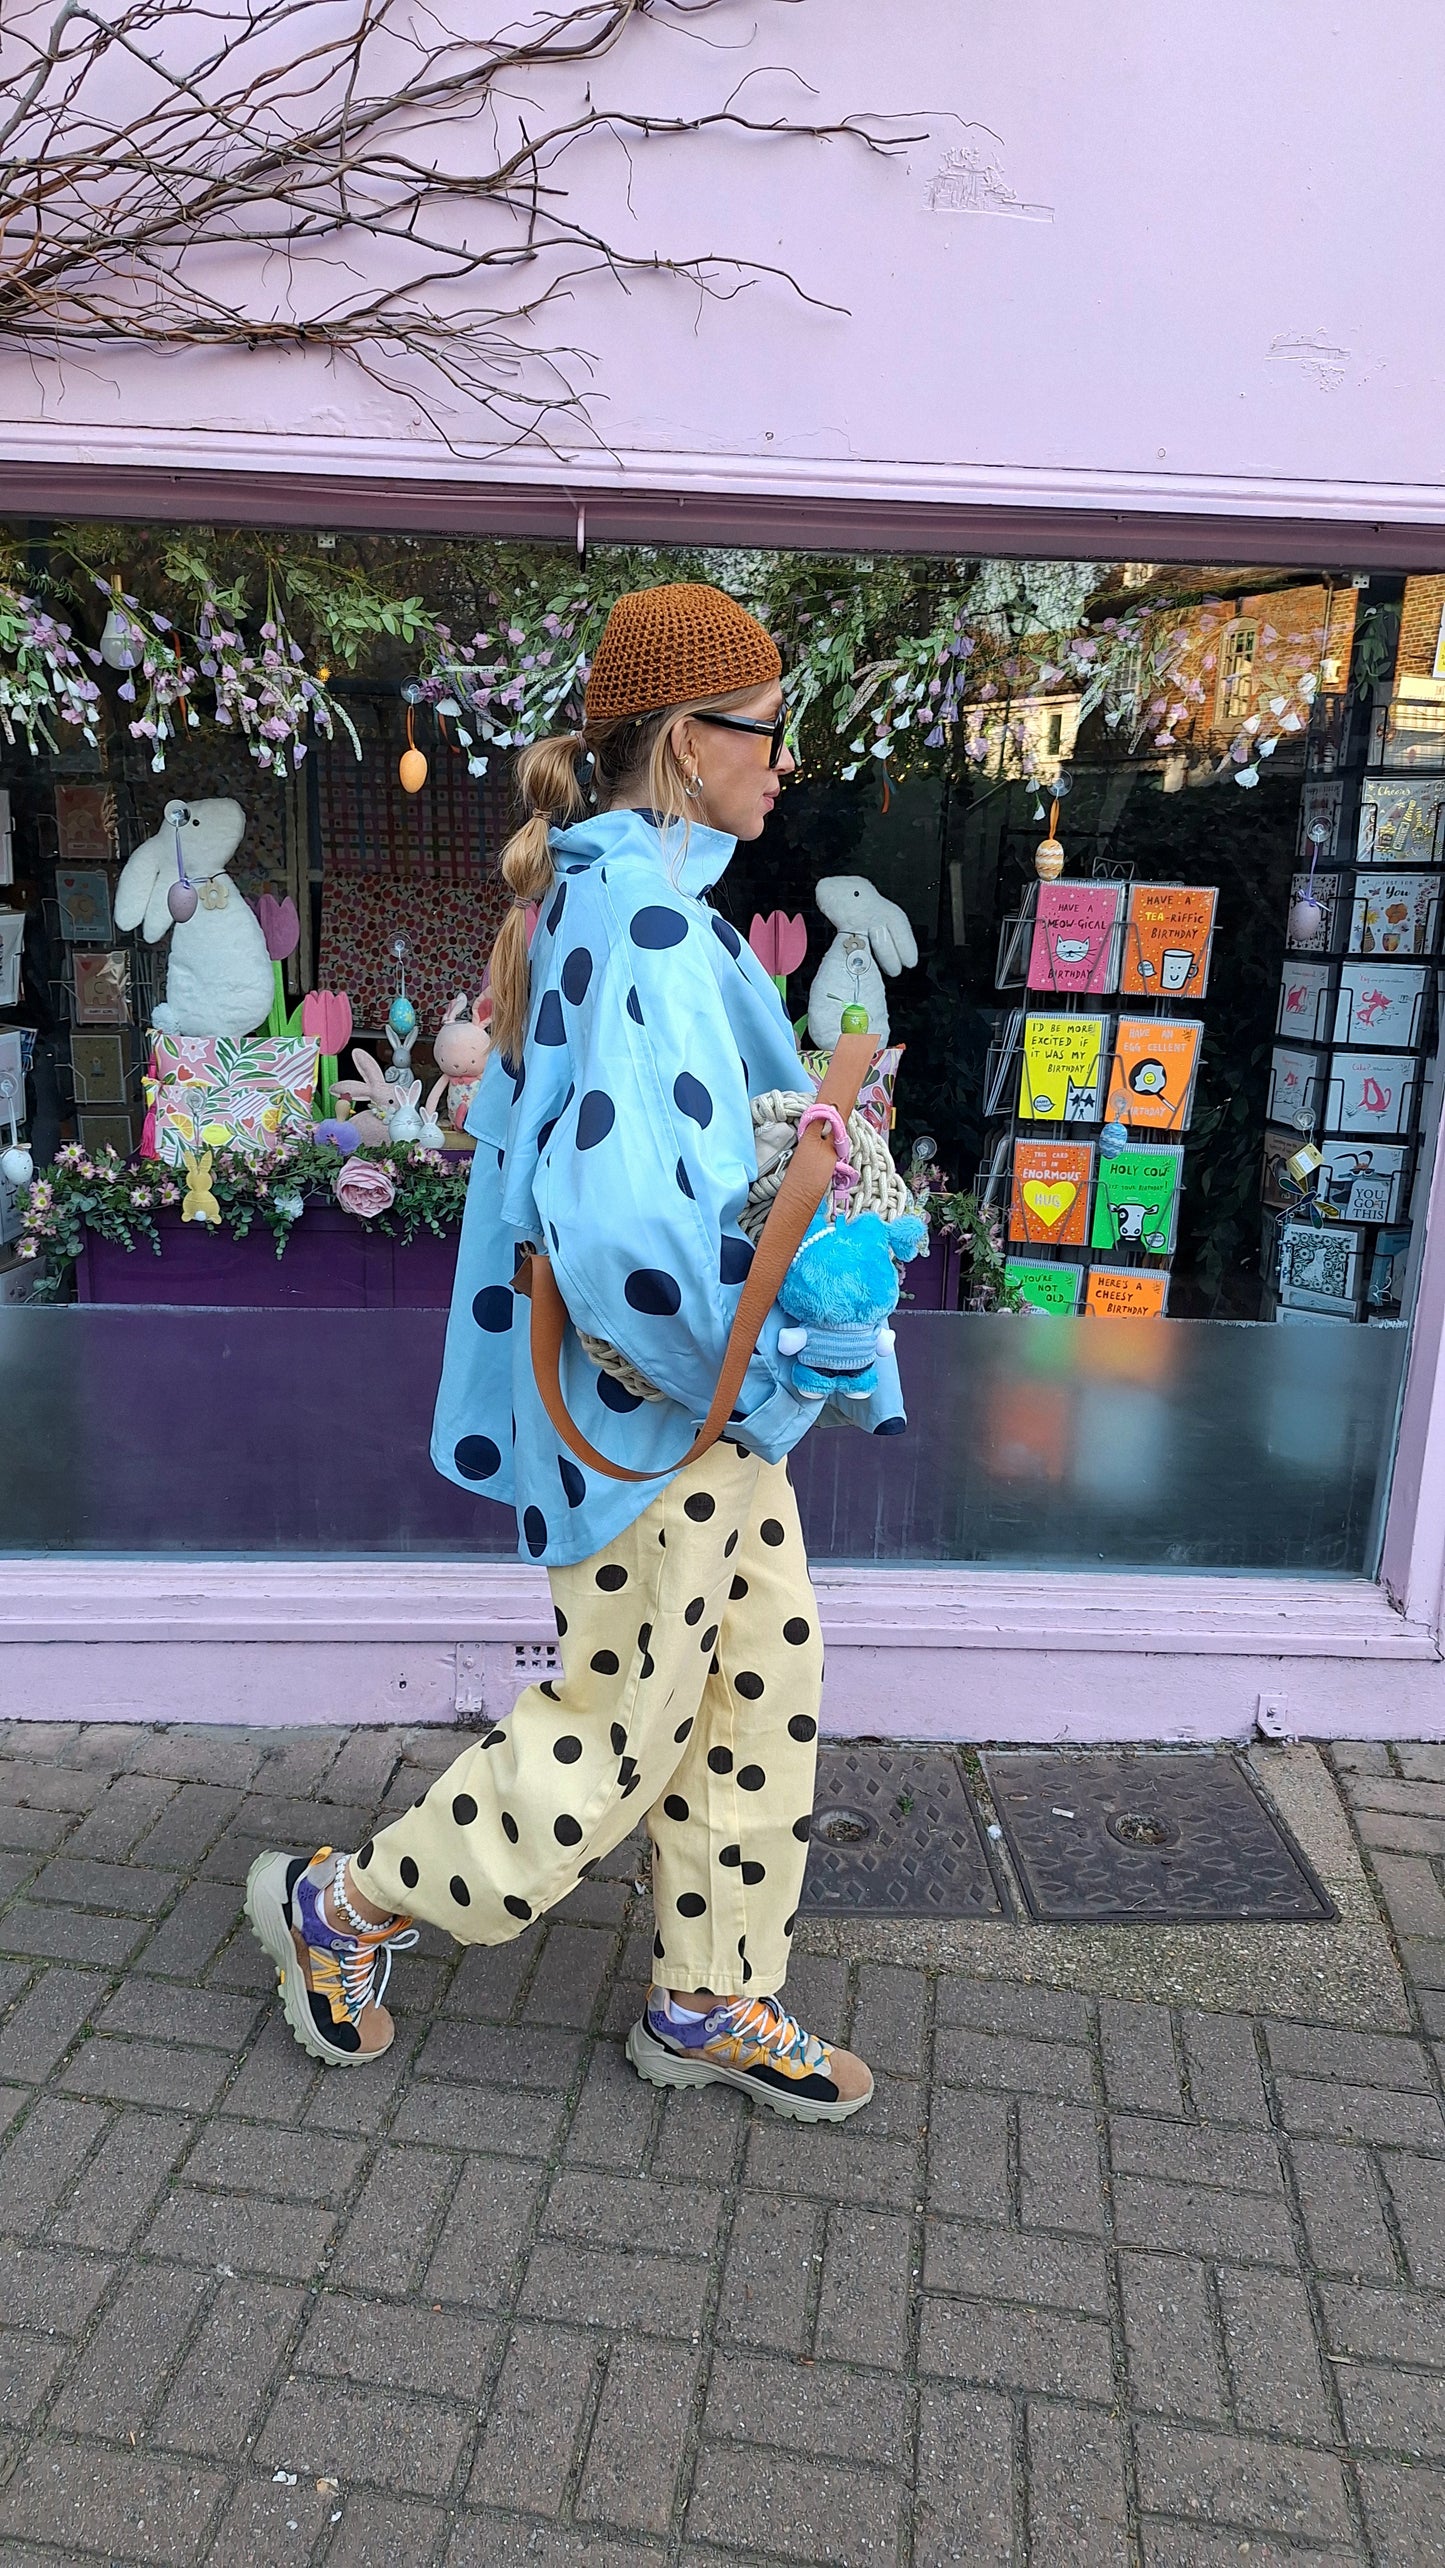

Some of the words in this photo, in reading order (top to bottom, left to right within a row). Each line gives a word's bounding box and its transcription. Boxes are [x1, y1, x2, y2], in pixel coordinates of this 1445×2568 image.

[1385, 885, 1409, 900] You
[1146, 895, 1174, 905] HAVE
[1184, 896, 1191, 905] A
[1058, 904, 1079, 912] HAVE
[1087, 904, 1093, 912] A
[1151, 927, 1199, 940] BIRTHDAY
[1048, 968, 1094, 980] BIRTHDAY
[1032, 1022, 1044, 1032] I'D
[1050, 1023, 1061, 1032] BE
[1129, 1028, 1151, 1039] HAVE
[1161, 1029, 1173, 1039] AN
[1123, 1042, 1141, 1052] EGG
[1147, 1042, 1187, 1052] CELLENT
[1045, 1049, 1065, 1060] WAS
[1071, 1051, 1086, 1060] MY
[1022, 1168, 1082, 1181] ENORMOUS
[1110, 1163, 1139, 1177] HOLY
[1143, 1166, 1168, 1177] COW
[1355, 1188, 1385, 1200] YOU
[1034, 1193, 1061, 1209] HUG
[1353, 1199, 1387, 1209] GOT
[1353, 1208, 1384, 1220] THIS
[1023, 1274, 1053, 1283] YOU'RE
[1098, 1277, 1128, 1289] HERE'S
[1038, 1284, 1058, 1292] NOT
[1095, 1290, 1133, 1302] CHEESY
[1107, 1303, 1149, 1317] BIRTHDAY
